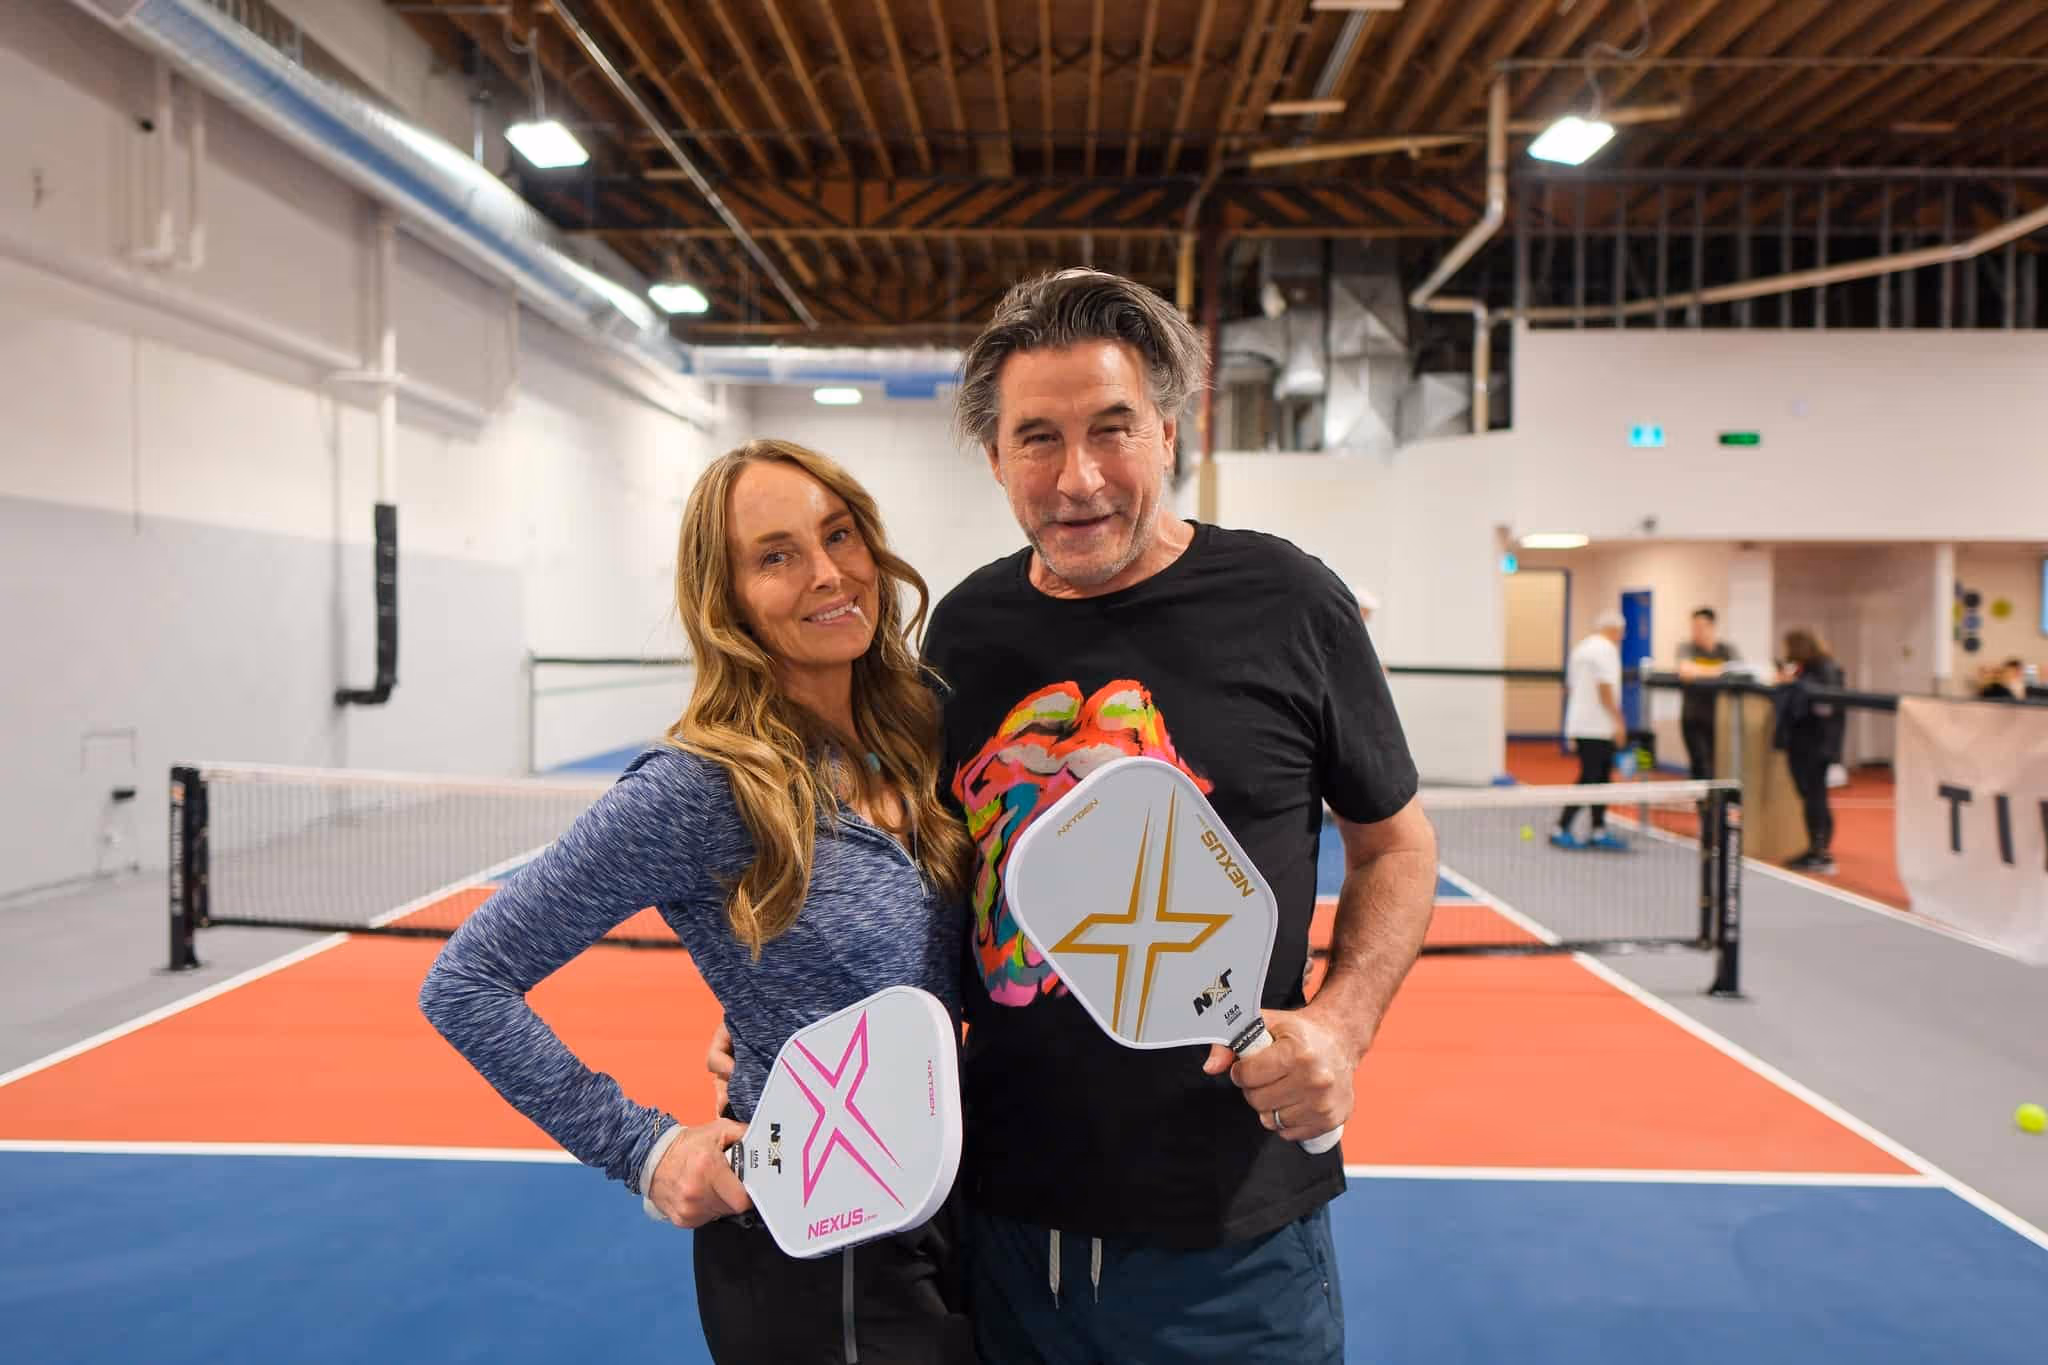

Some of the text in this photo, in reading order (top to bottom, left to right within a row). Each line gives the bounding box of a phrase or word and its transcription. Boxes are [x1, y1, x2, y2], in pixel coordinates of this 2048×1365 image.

[1938, 783, 2048, 873] TI
[1200, 830, 1254, 898] NEXUS
[1193, 968, 1233, 1016] NXT
[1224, 1004, 1240, 1020] USA
[770, 1123, 782, 1174] NXT
[807, 1207, 864, 1240] NEXUS
